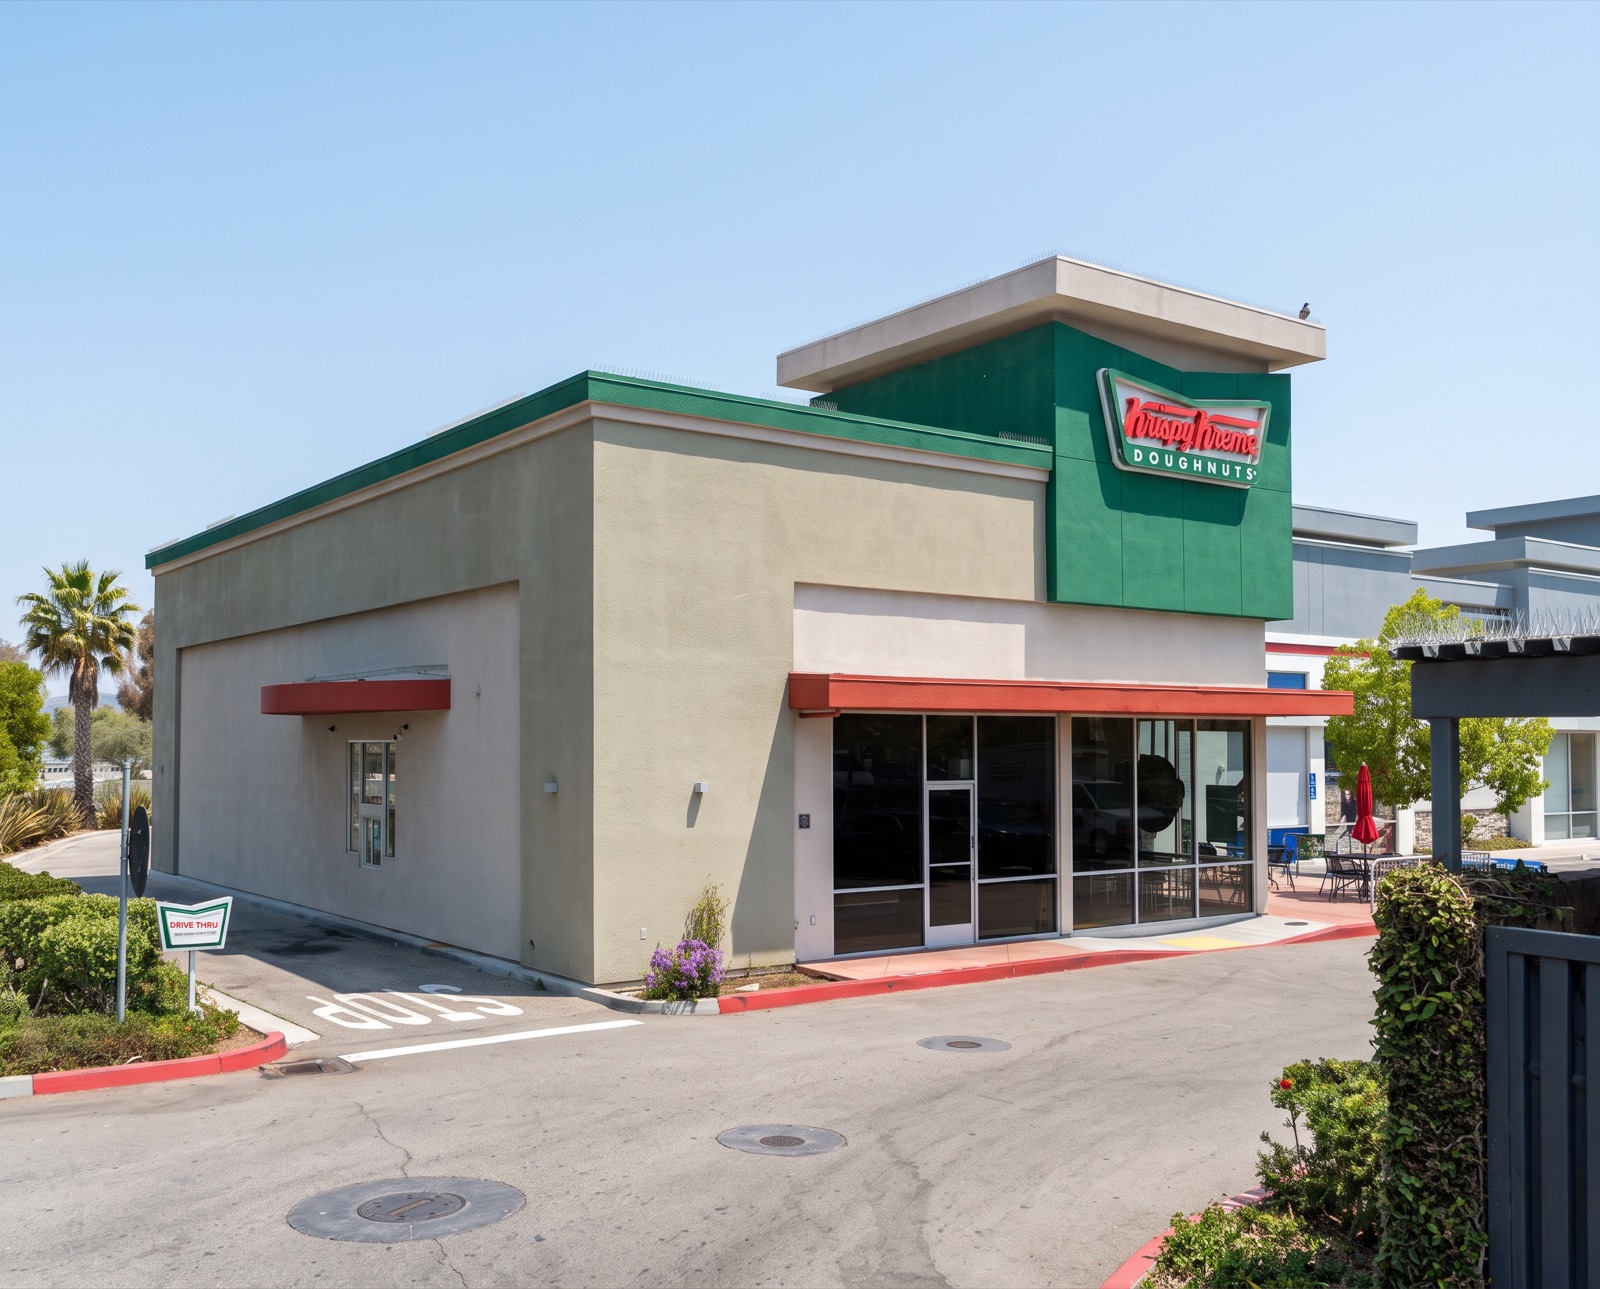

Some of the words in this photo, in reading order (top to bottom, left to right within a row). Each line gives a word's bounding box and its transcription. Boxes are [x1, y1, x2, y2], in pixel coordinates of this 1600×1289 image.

[1123, 397, 1198, 452] Krispy
[1195, 410, 1261, 455] Kreme
[1134, 448, 1254, 480] DOUGHNUTS
[306, 984, 524, 1029] STOP
